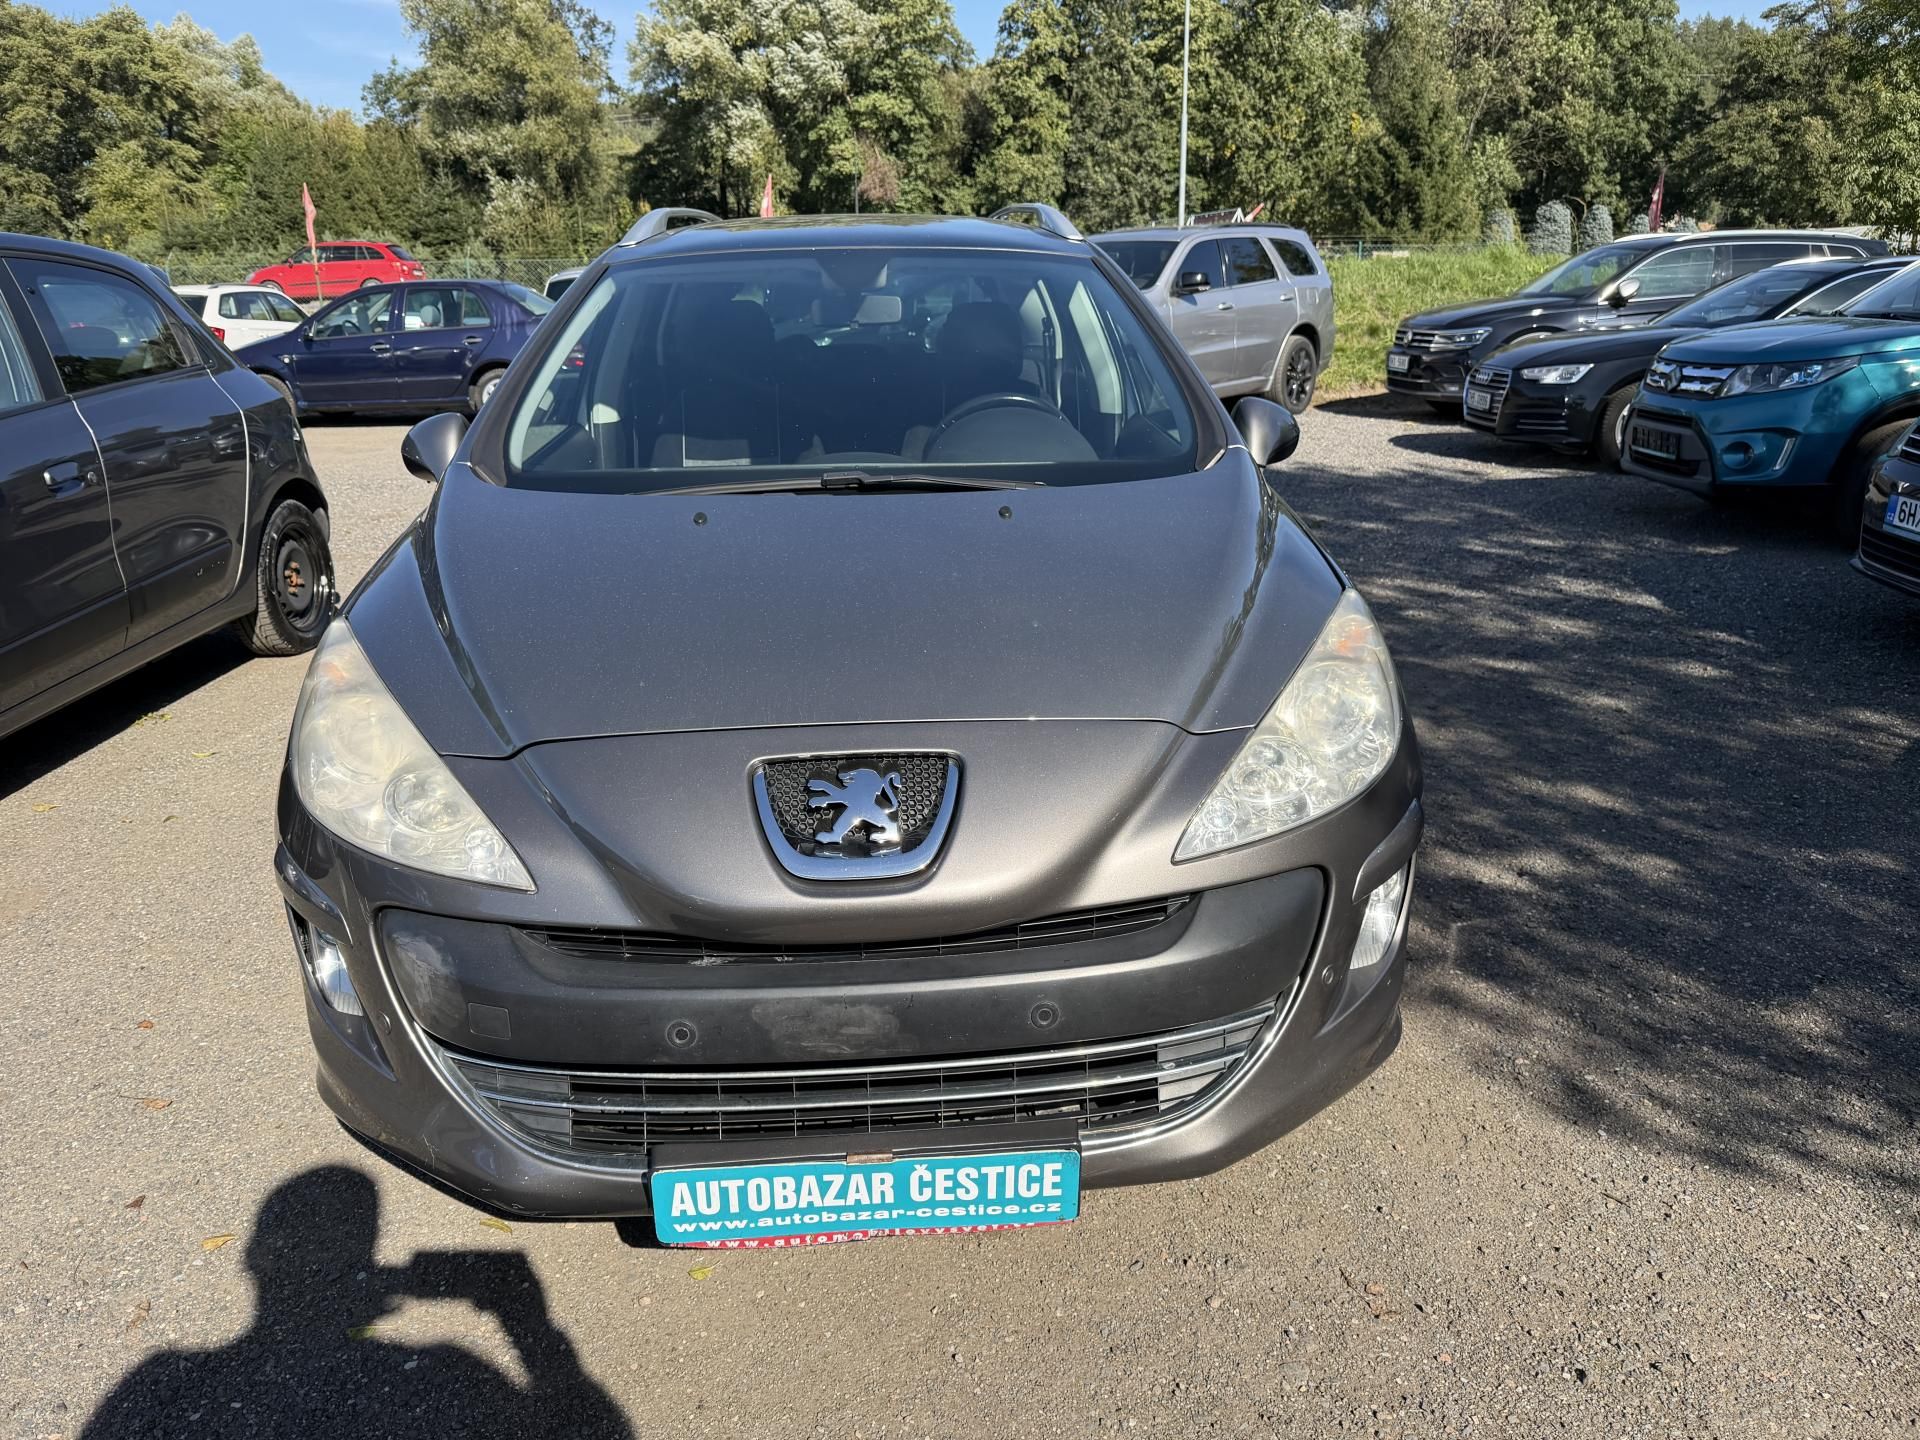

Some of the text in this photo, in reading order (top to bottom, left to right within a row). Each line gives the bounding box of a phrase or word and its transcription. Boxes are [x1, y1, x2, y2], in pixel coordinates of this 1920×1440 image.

[1887, 512, 1895, 521] CZ
[672, 1163, 1063, 1217] AUTOBAZAR ČESTICE
[673, 1202, 1062, 1233] www.autobazar-cestice.cz
